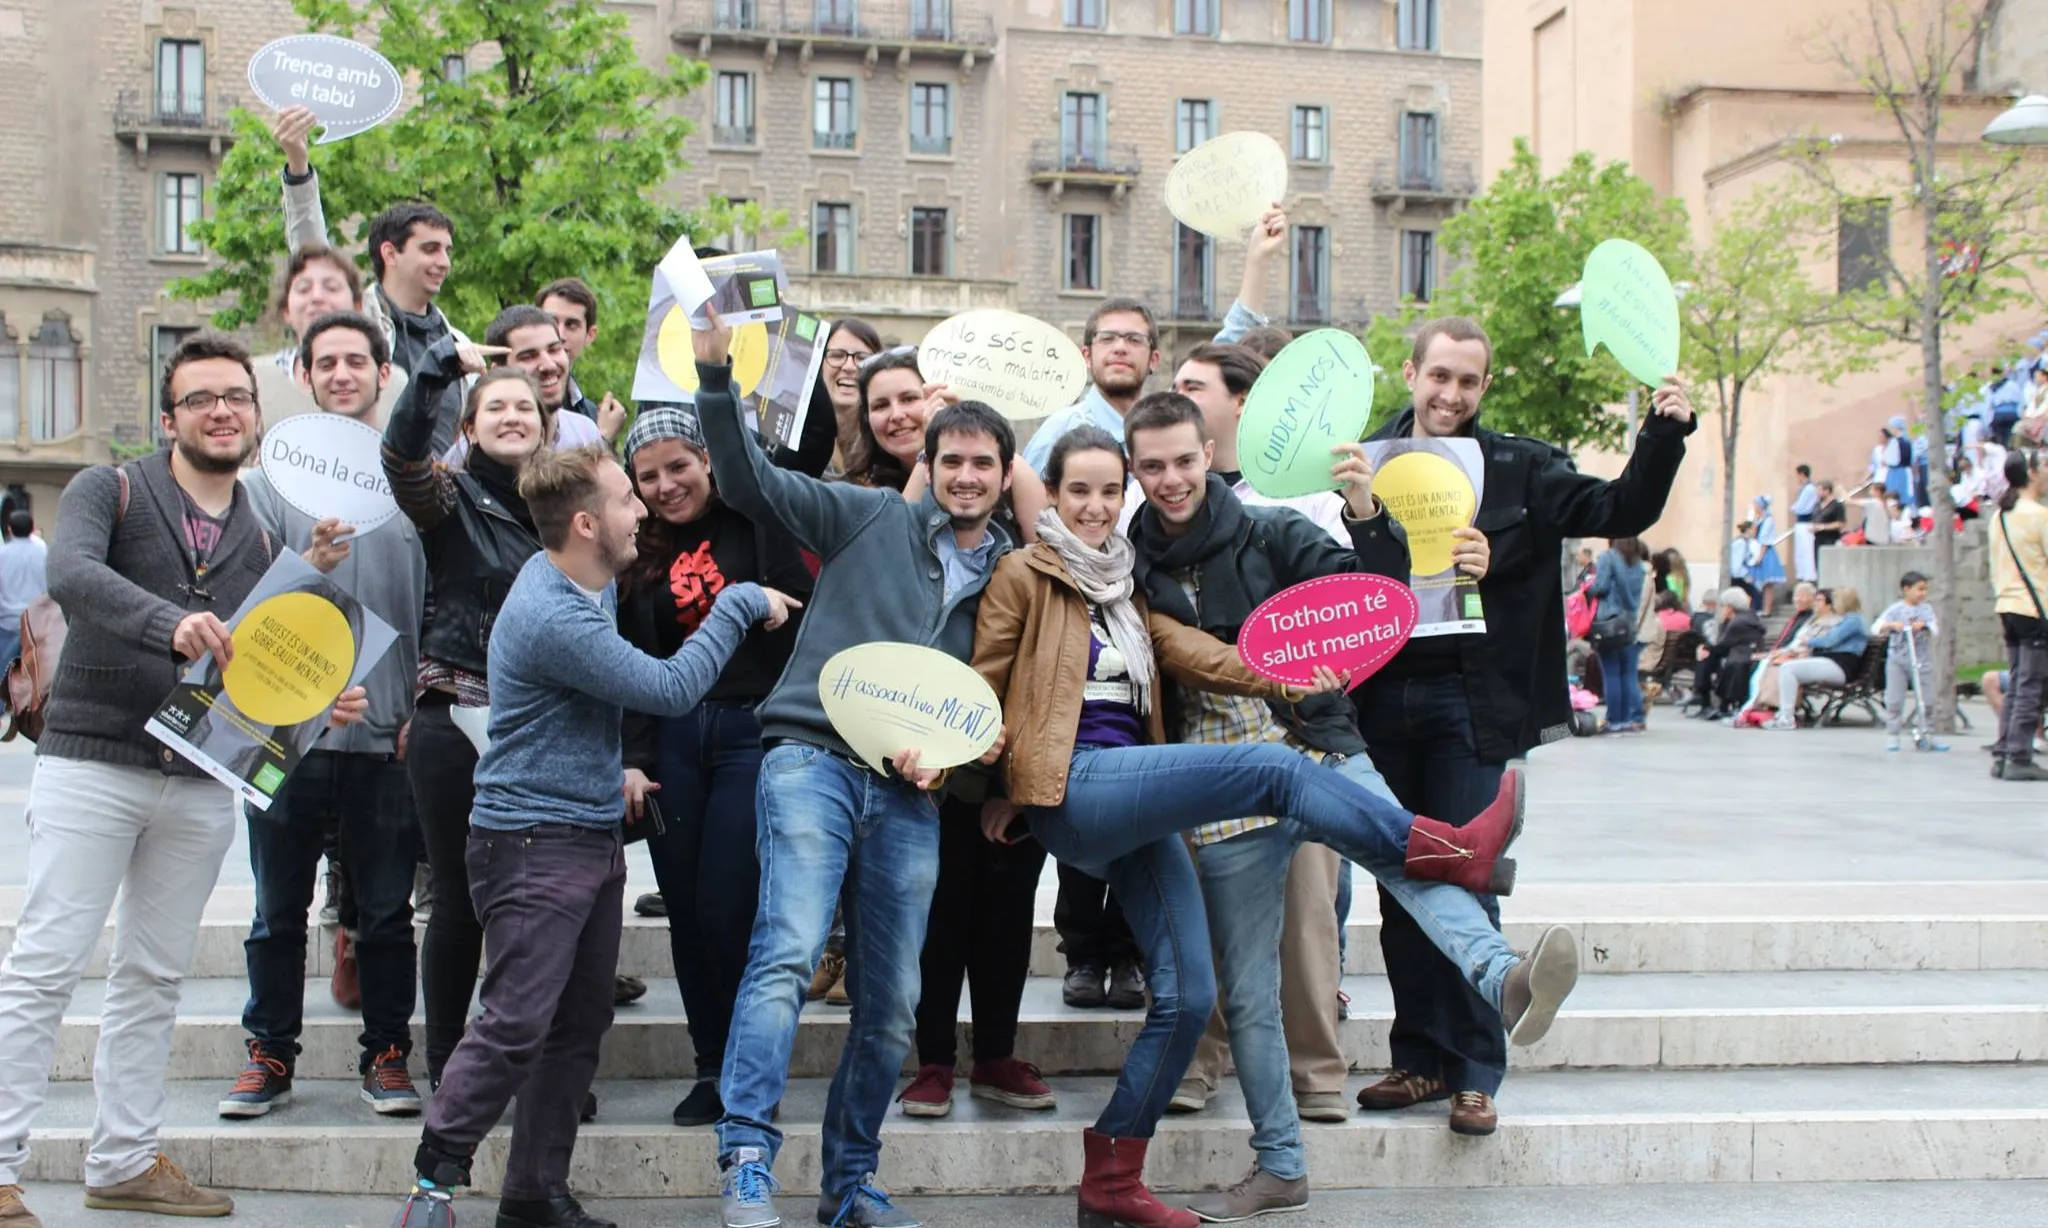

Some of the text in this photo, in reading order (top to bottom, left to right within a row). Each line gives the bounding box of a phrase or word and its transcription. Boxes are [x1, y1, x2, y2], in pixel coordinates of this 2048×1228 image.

[273, 51, 381, 89] Trenca amb
[290, 80, 356, 108] el tabú
[950, 321, 1060, 360] No sóc la
[272, 439, 327, 475] Dóna
[331, 457, 349, 482] la
[1417, 492, 1429, 505] UN
[1431, 490, 1462, 503] ANUNCI
[1264, 588, 1388, 634] Tothom té
[250, 628, 277, 652] SOBRE
[272, 645, 299, 668] SALUT
[260, 615, 292, 641] AQUEST
[296, 641, 311, 656] UN
[308, 651, 338, 677] ANUNCI
[1262, 616, 1400, 667] salut mental
